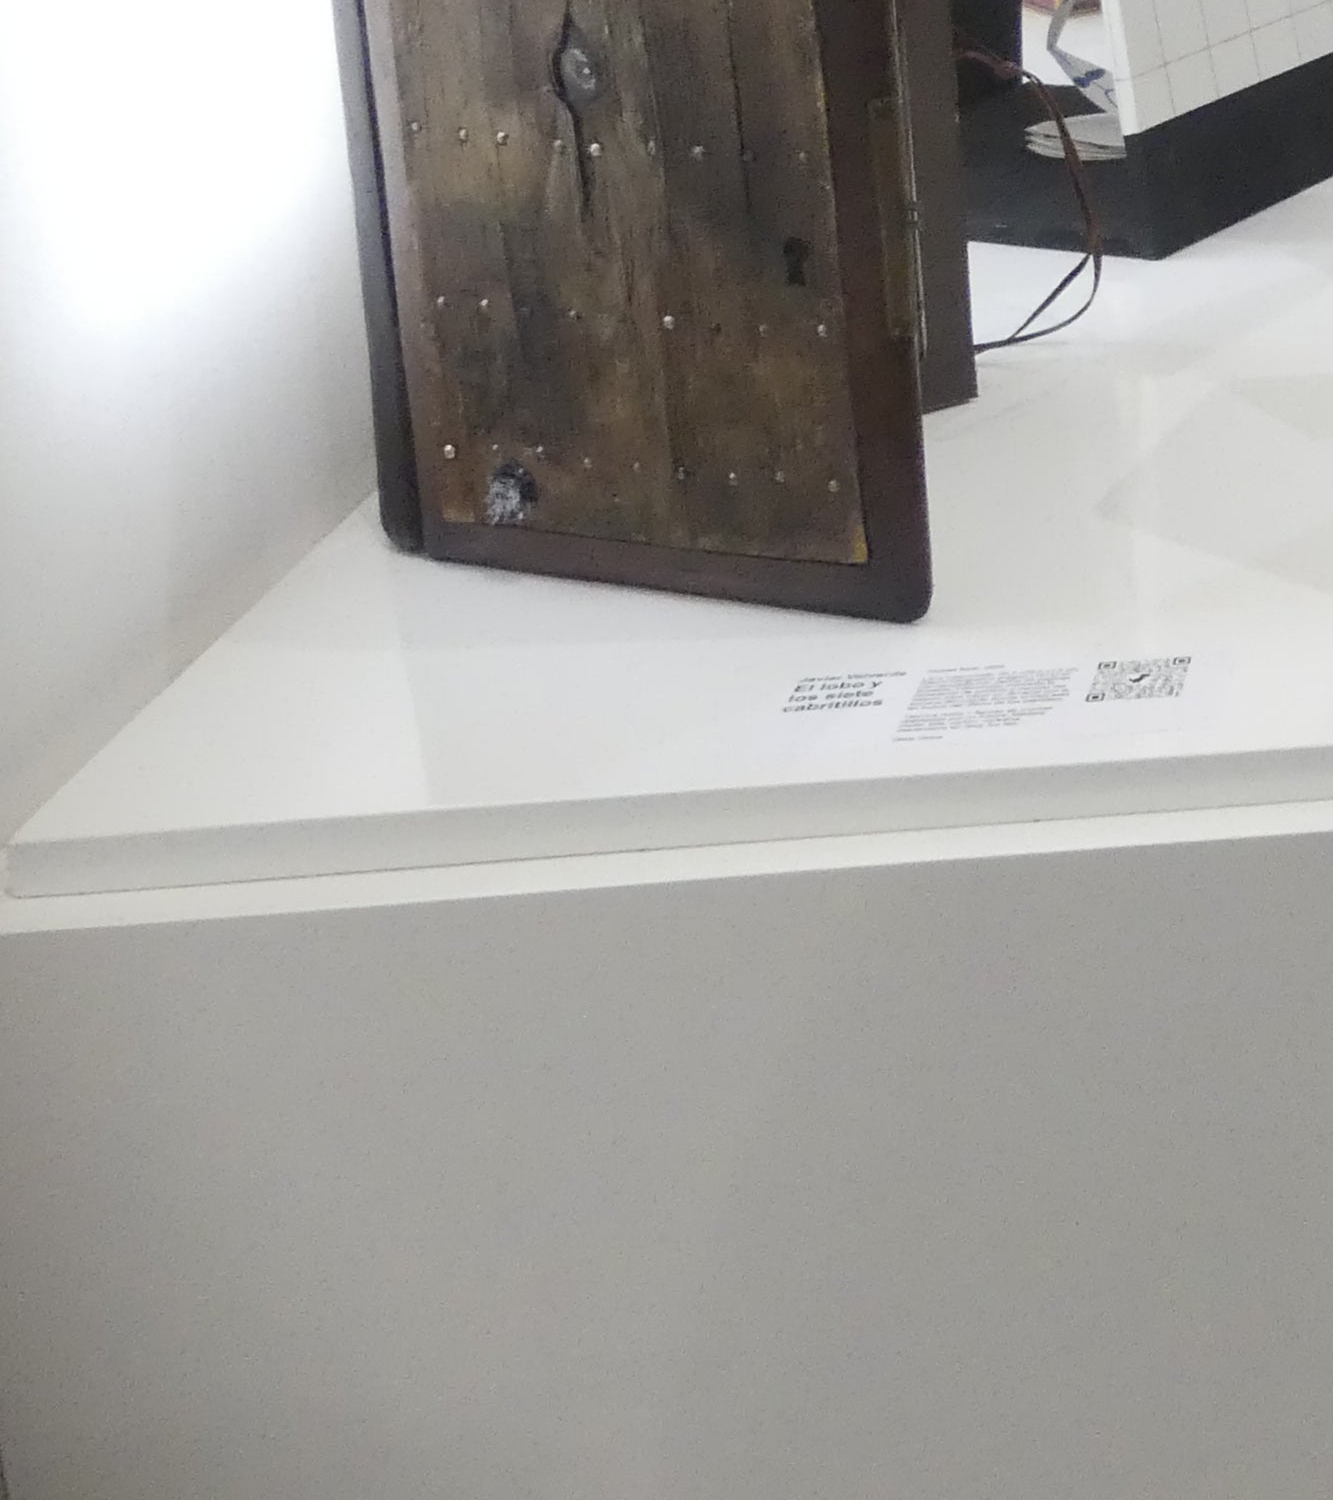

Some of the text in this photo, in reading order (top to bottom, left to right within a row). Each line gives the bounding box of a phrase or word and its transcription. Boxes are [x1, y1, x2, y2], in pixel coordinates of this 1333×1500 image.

[794, 680, 884, 693] El lobo y
[787, 690, 875, 703] los siete
[782, 699, 884, 713] cabritillos
